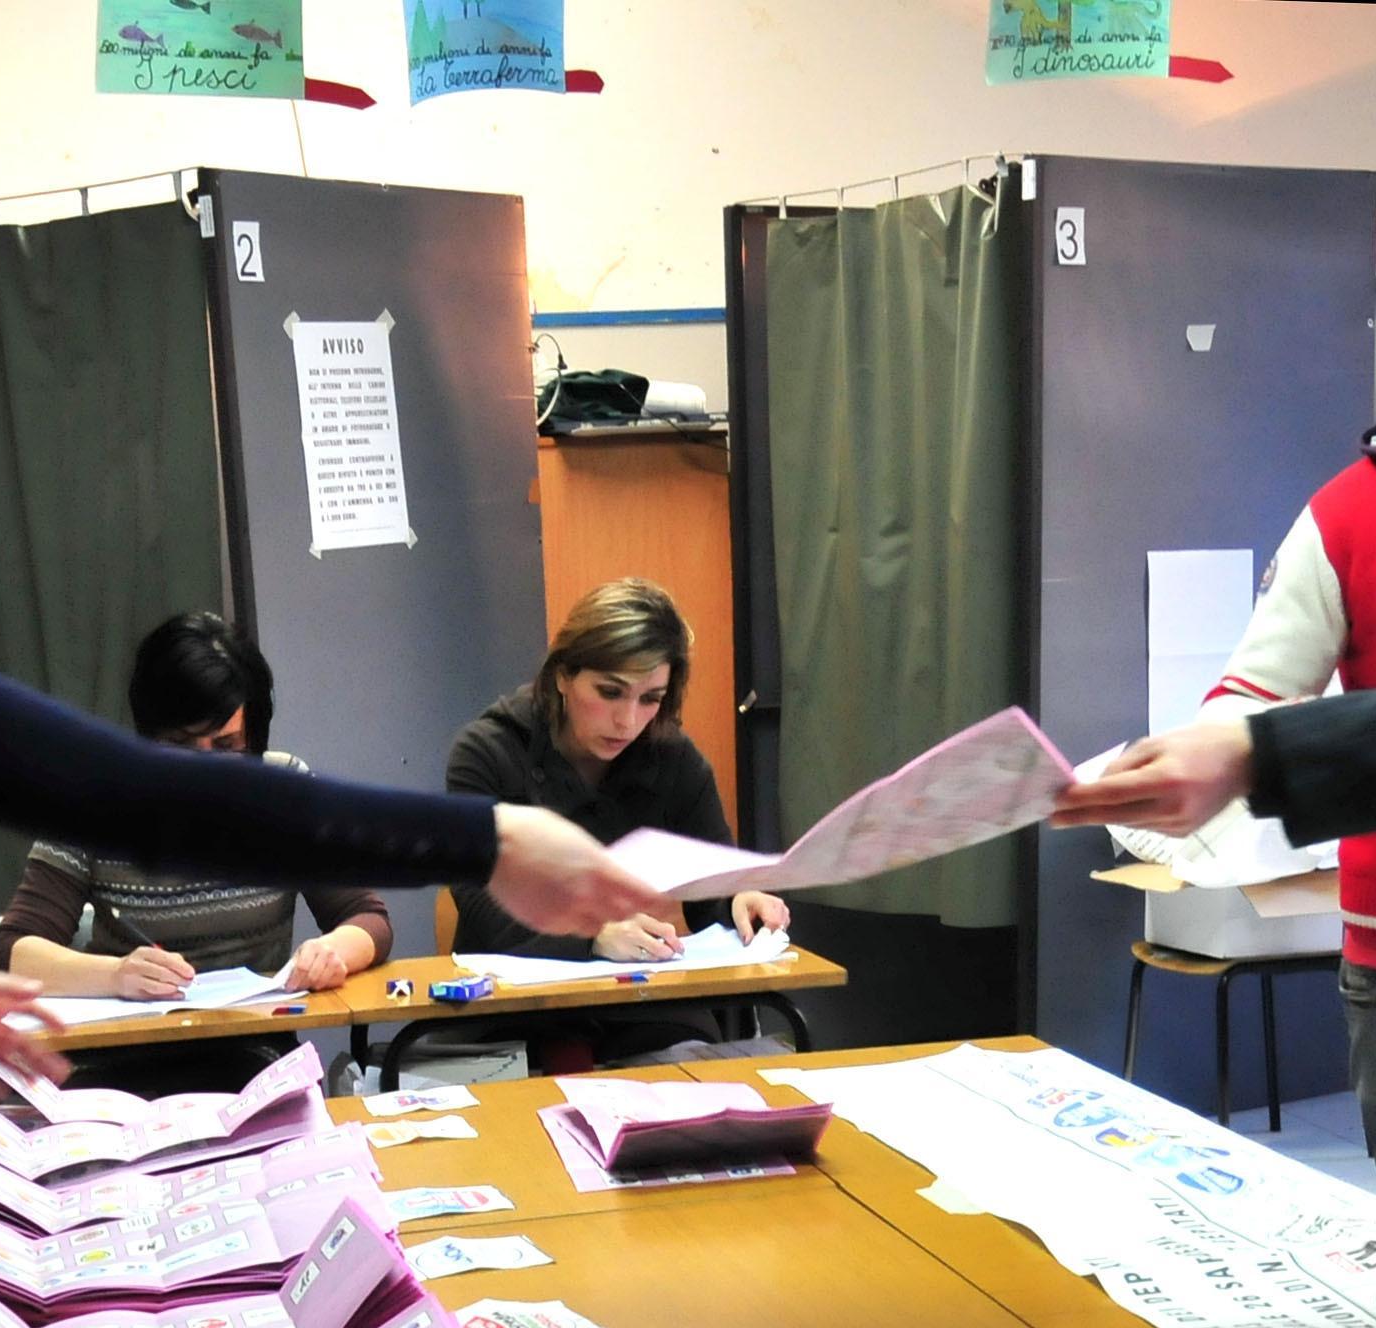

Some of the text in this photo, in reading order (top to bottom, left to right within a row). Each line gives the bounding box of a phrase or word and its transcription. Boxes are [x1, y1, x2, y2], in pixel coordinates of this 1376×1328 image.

[1031, 46, 1156, 75] dinosauri
[162, 62, 258, 93] pesci
[237, 233, 257, 277] 2
[1059, 219, 1079, 260] 3
[322, 338, 365, 355] AVVISO
